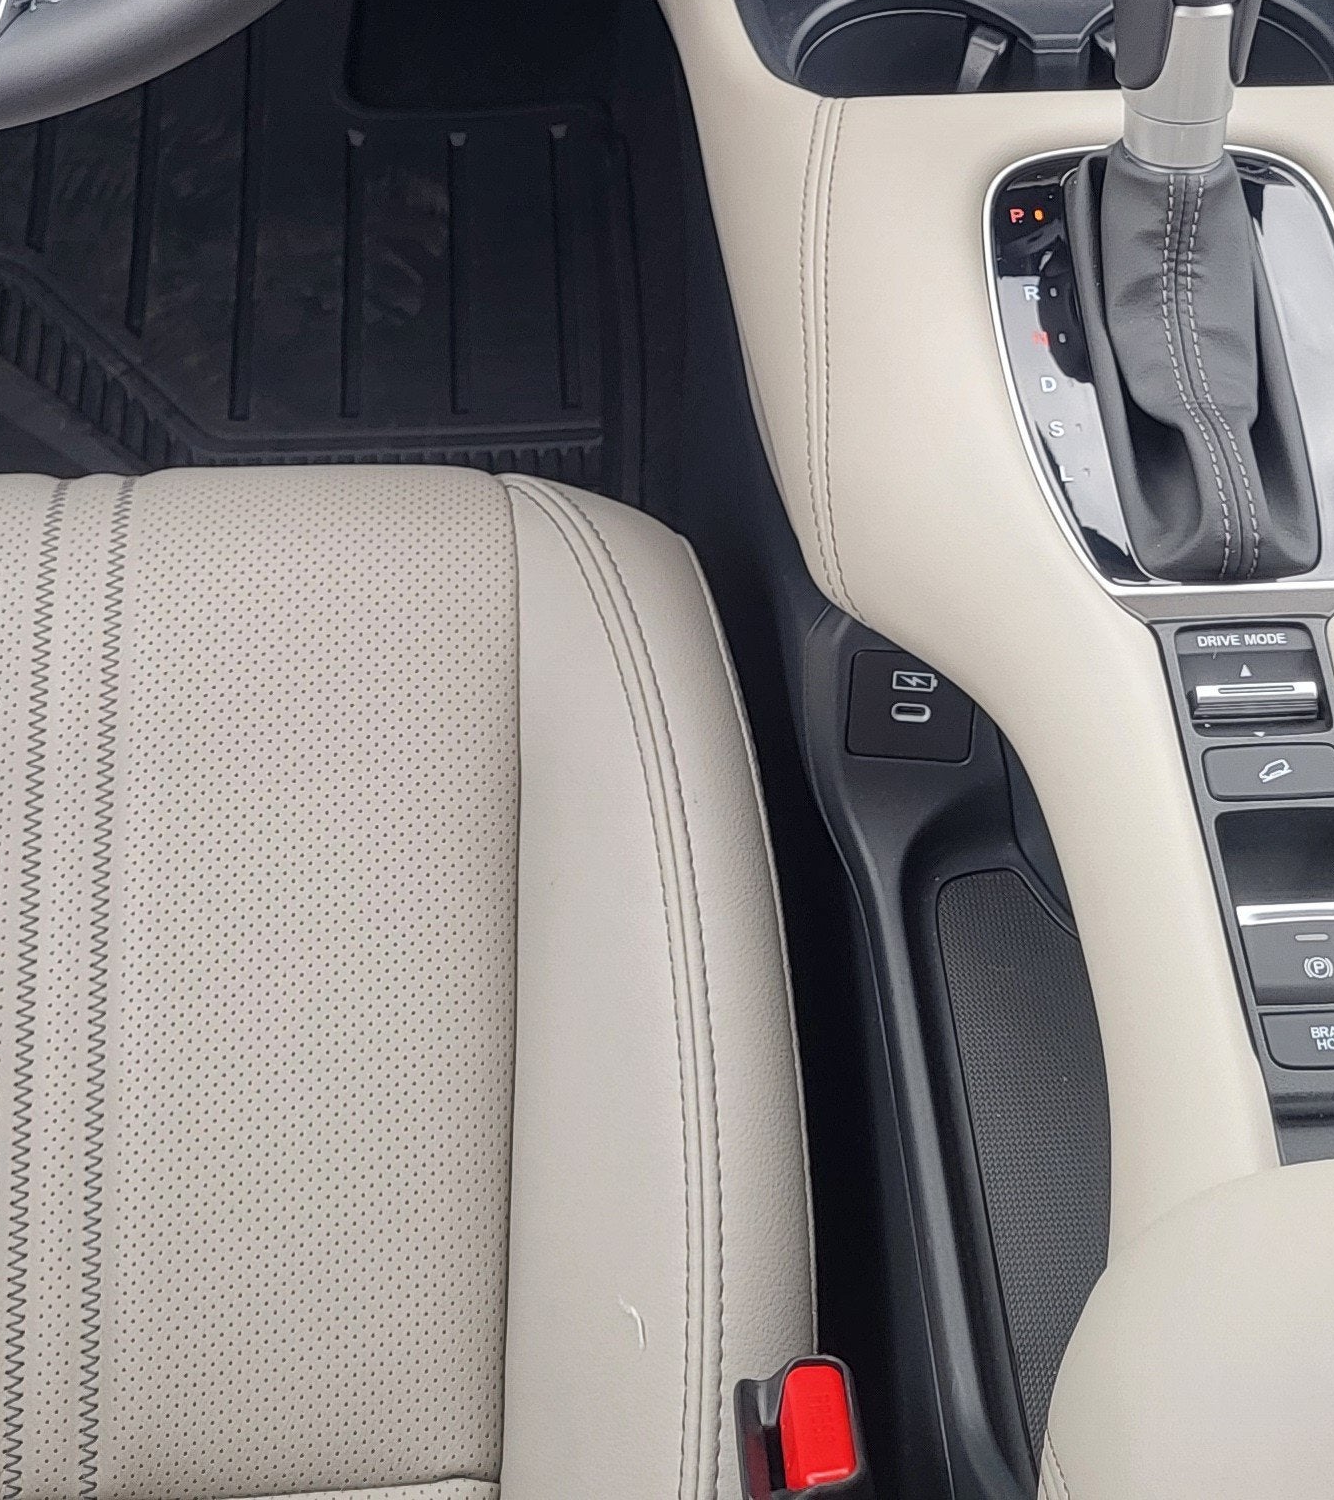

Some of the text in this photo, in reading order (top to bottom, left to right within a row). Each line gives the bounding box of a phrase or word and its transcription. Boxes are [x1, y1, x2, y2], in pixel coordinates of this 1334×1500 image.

[1010, 208, 1025, 223] P
[1023, 285, 1040, 301] R
[1032, 330, 1049, 347] N
[1040, 376, 1057, 393] D
[1049, 421, 1065, 437] S
[1059, 464, 1074, 482] L
[1196, 632, 1288, 648] DRIVE MODE
